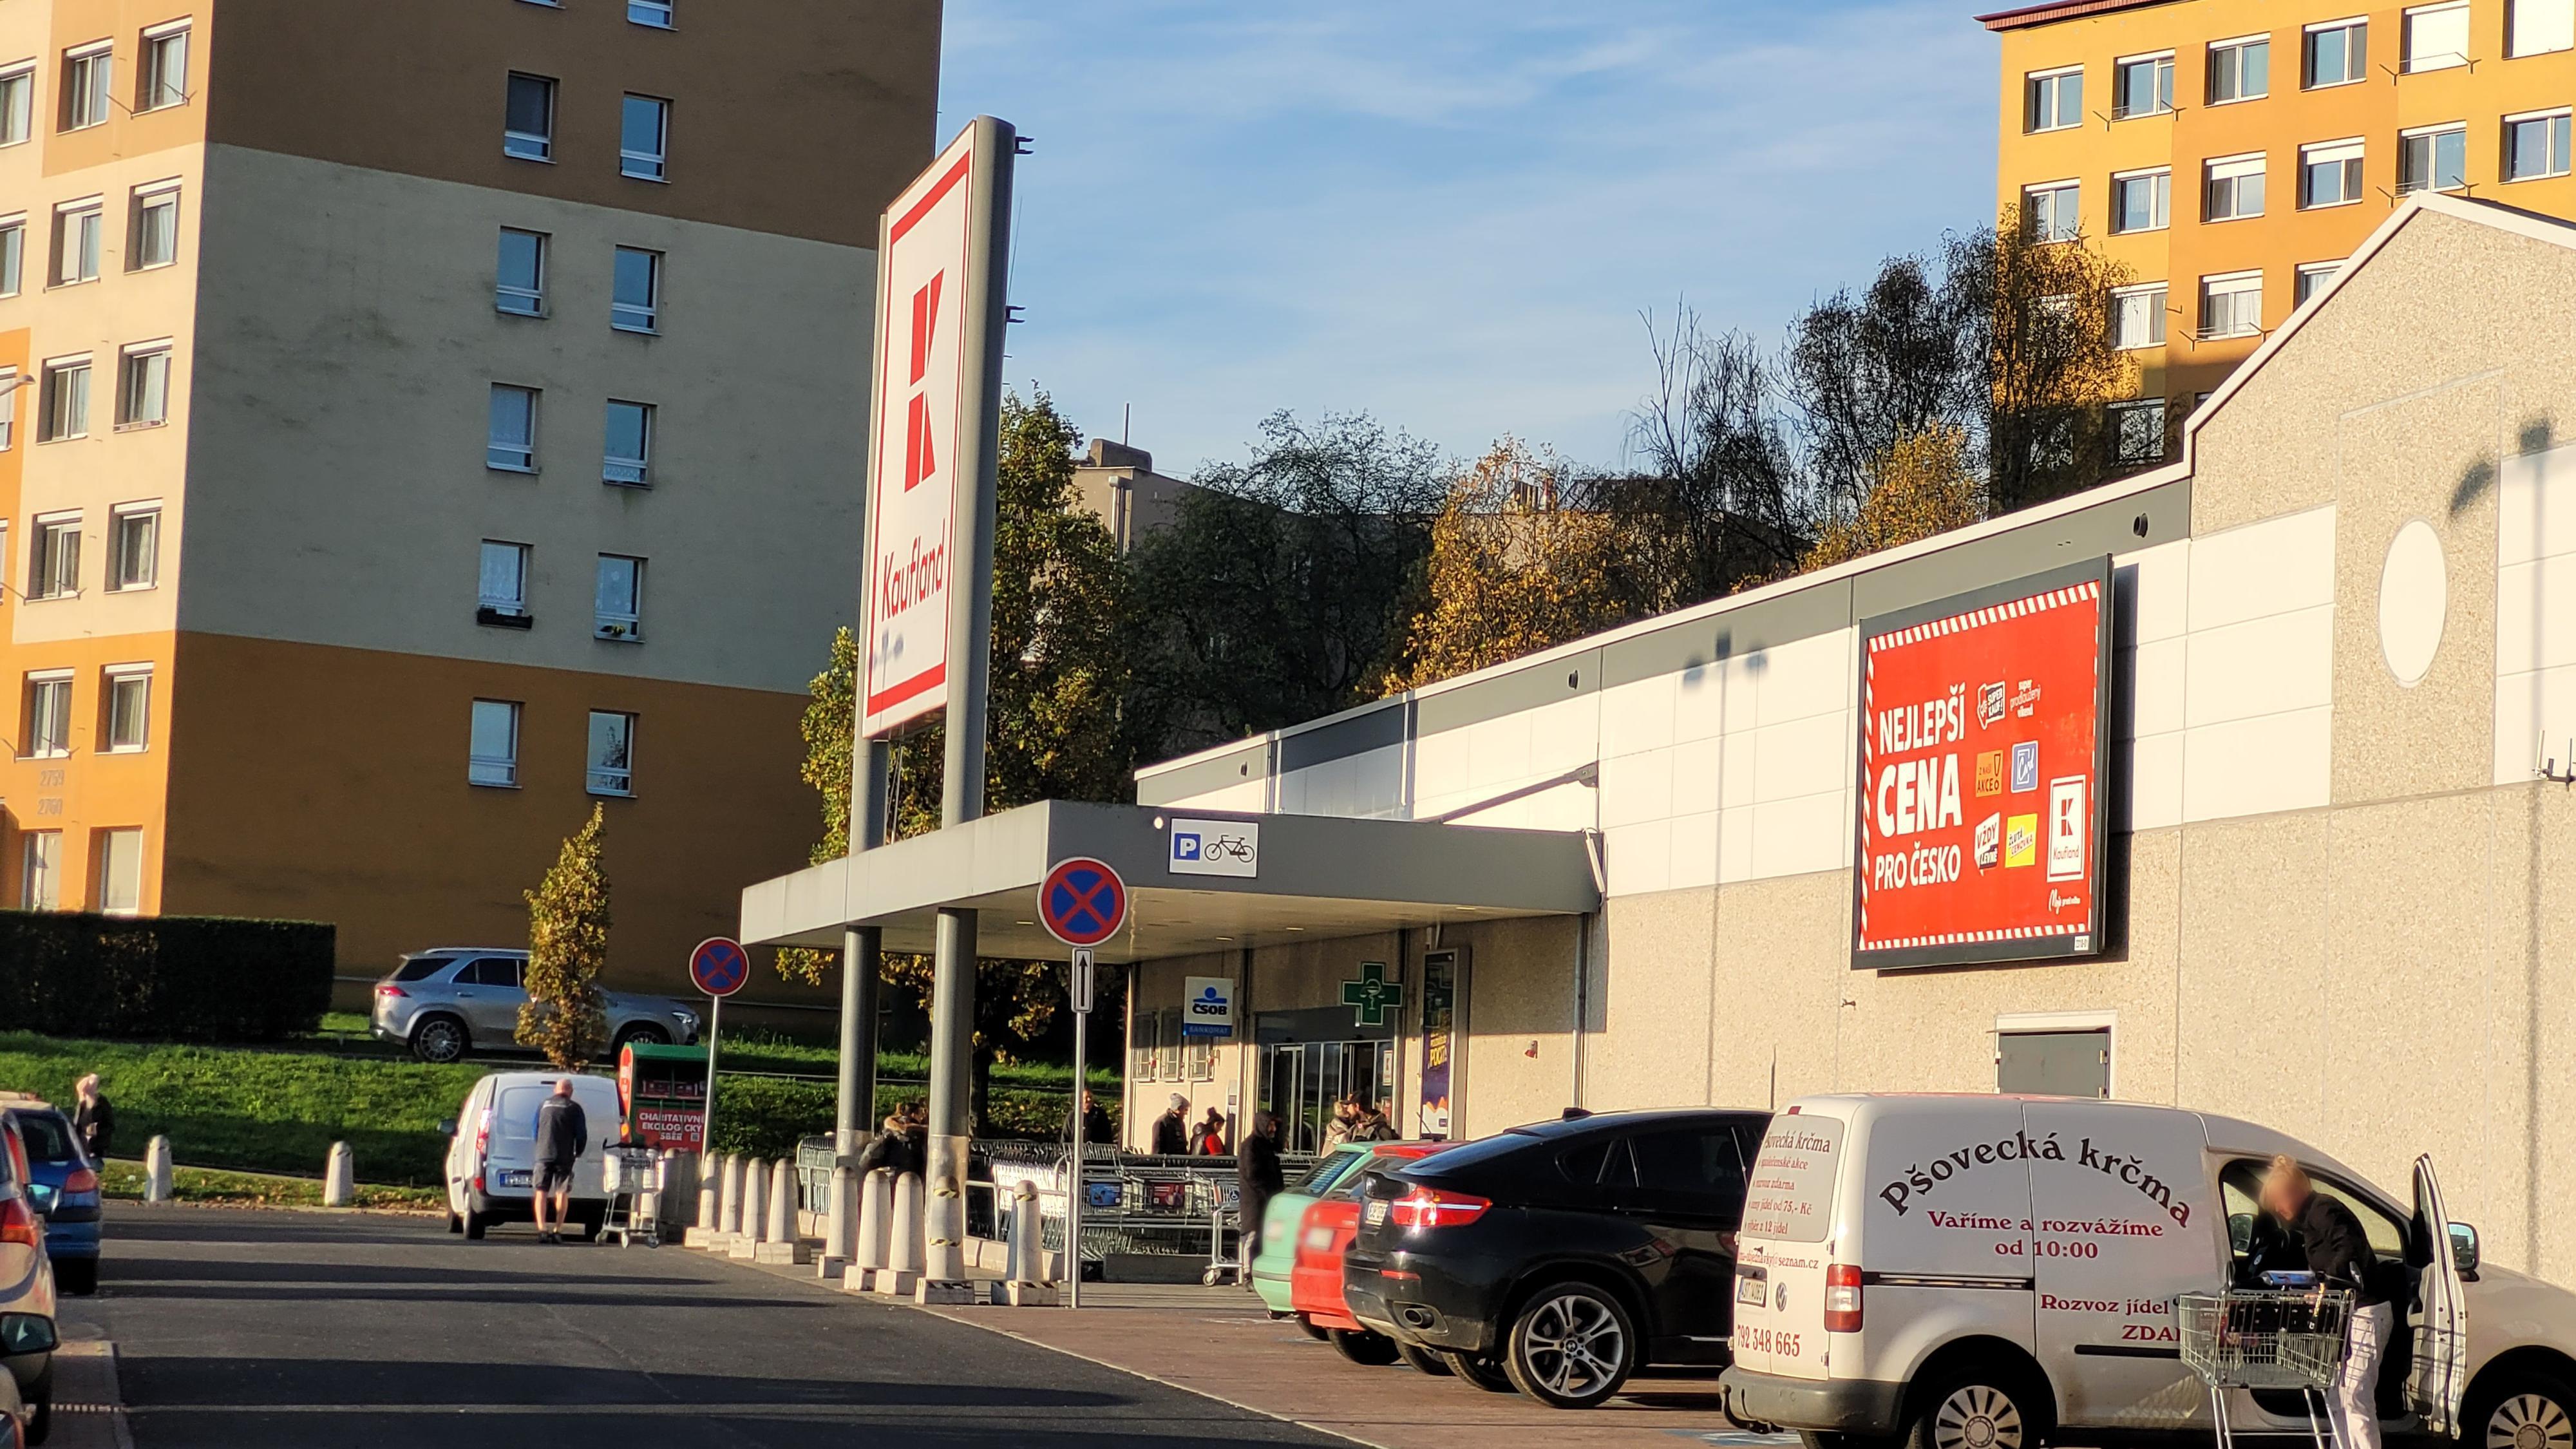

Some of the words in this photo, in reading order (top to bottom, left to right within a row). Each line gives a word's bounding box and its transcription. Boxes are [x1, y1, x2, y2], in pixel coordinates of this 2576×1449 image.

[882, 517, 945, 623] Kaufland
[1879, 682, 1965, 755] NEJLEPŠÍ
[1877, 753, 1963, 838] CENA
[1977, 822, 1997, 849] VŽDY
[1180, 838, 1197, 857] P
[1980, 848, 1998, 865] LEVNĚ
[2053, 844, 2079, 860] Kaufland
[1875, 852, 1908, 891] PRO
[1910, 840, 1962, 887] ČESKO
[1192, 1003, 1227, 1015] ČSOB
[642, 1122, 702, 1133] EKOLOGCKÝ
[1764, 1130, 1796, 1149] šovecká
[1795, 1131, 1830, 1153] krčma
[1791, 1157, 1808, 1170] akce
[1770, 1177, 1794, 1190] zdarma
[1879, 1130, 2065, 1217] Pšovecká
[2078, 1138, 2190, 1228] krčma
[1773, 1198, 1783, 1211] od
[1800, 1202, 1812, 1215] Kč
[1765, 1221, 1772, 1232] 12
[1927, 1211, 2012, 1229] Vaříme
[2020, 1219, 2034, 1231] a
[2041, 1218, 2164, 1236] rozvážíme
[1995, 1239, 2023, 1255] od
[2034, 1240, 2098, 1258] 10:00
[2040, 1294, 2119, 1312] Rozvoz
[2125, 1298, 2170, 1316] jídel
[1738, 1324, 1750, 1349] 792
[1753, 1328, 1772, 1353] 348
[1776, 1331, 1801, 1358] 665
